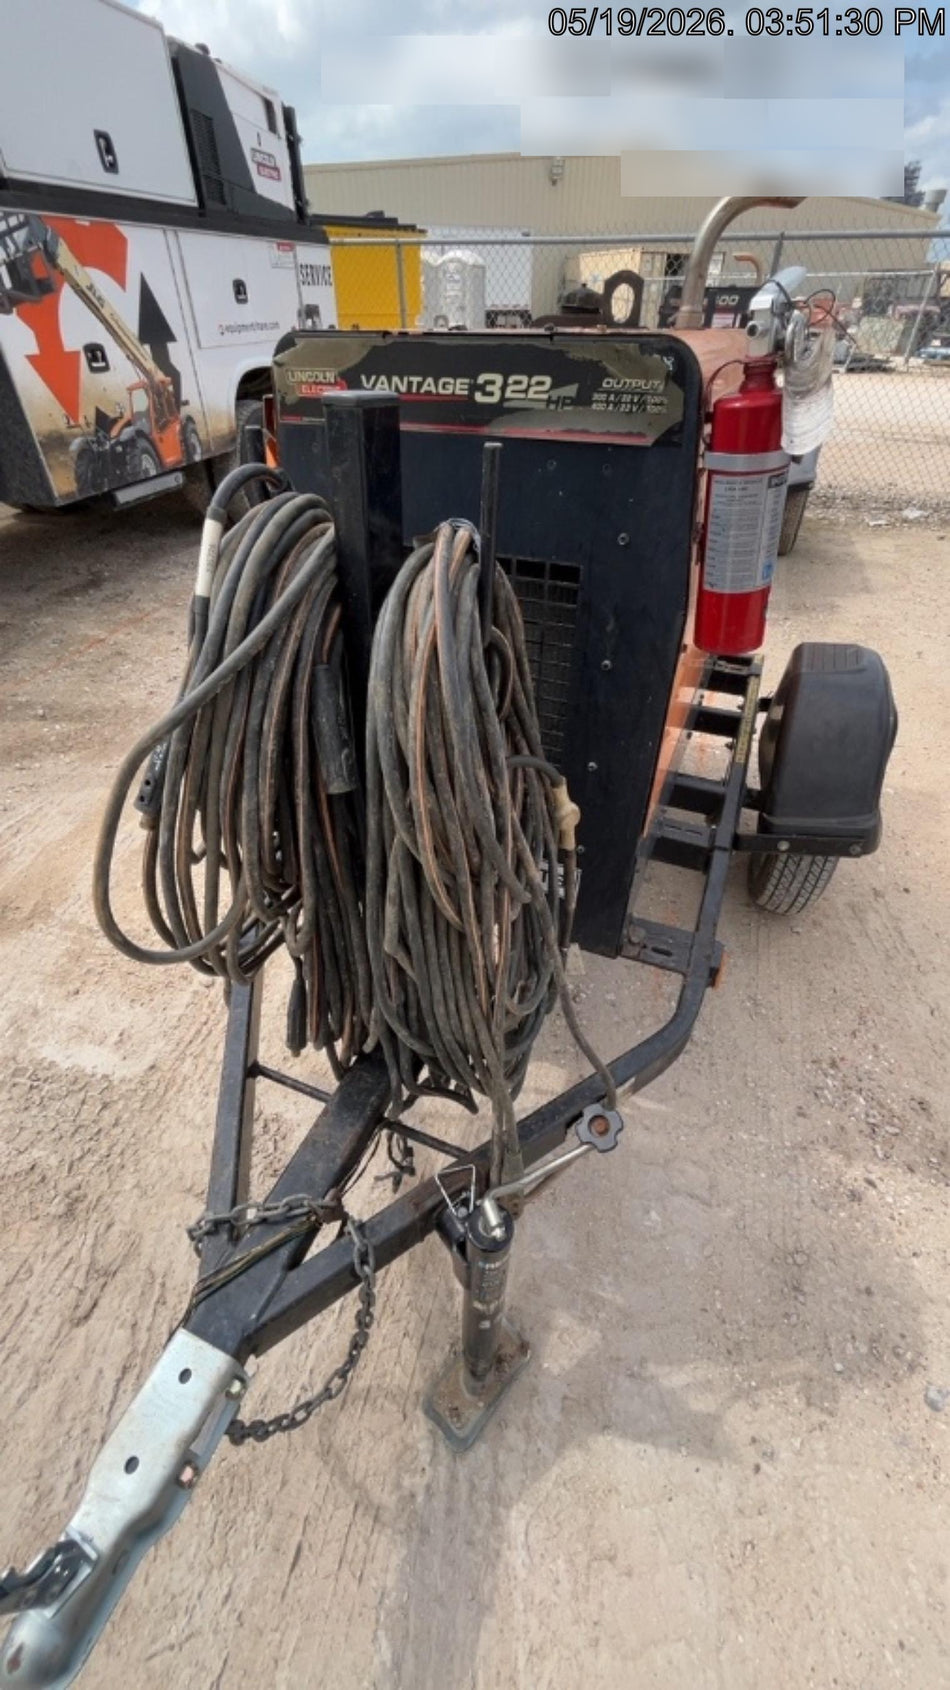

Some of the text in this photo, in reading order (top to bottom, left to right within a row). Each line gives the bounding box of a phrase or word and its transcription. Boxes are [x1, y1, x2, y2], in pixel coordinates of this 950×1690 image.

[299, 263, 333, 287] SERVICE
[288, 370, 335, 384] LINCOLN
[602, 378, 661, 390] OUTPUT
[360, 374, 469, 395] VANTAGE
[474, 373, 552, 404] 322
